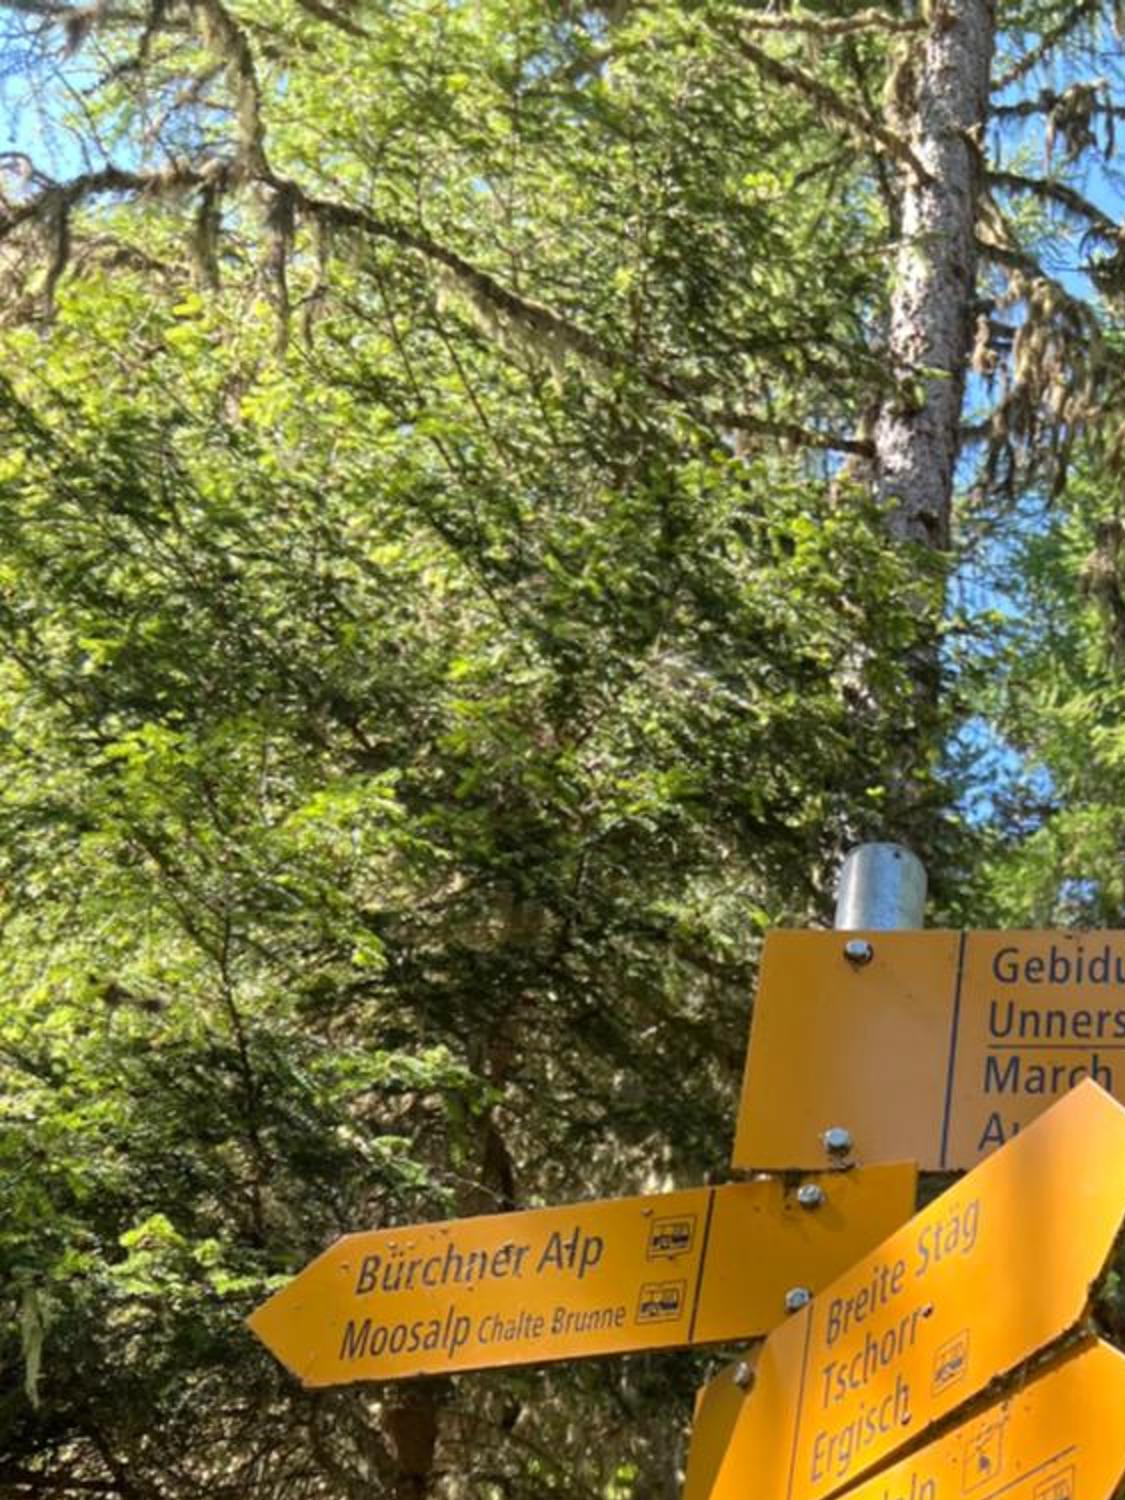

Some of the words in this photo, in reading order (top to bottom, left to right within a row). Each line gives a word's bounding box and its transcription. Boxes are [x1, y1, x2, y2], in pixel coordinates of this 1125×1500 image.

[983, 1054, 1113, 1095] March
[355, 1243, 530, 1295] Bürchner
[537, 1226, 604, 1279] Alp
[826, 1259, 907, 1345] Breite
[915, 1198, 981, 1277] Stäg
[339, 1305, 471, 1360] Moosalp
[477, 1311, 545, 1344] Chalte
[550, 1304, 627, 1335] Brunne
[823, 1303, 923, 1408] Tschorr
[810, 1371, 912, 1483] Ergisch
